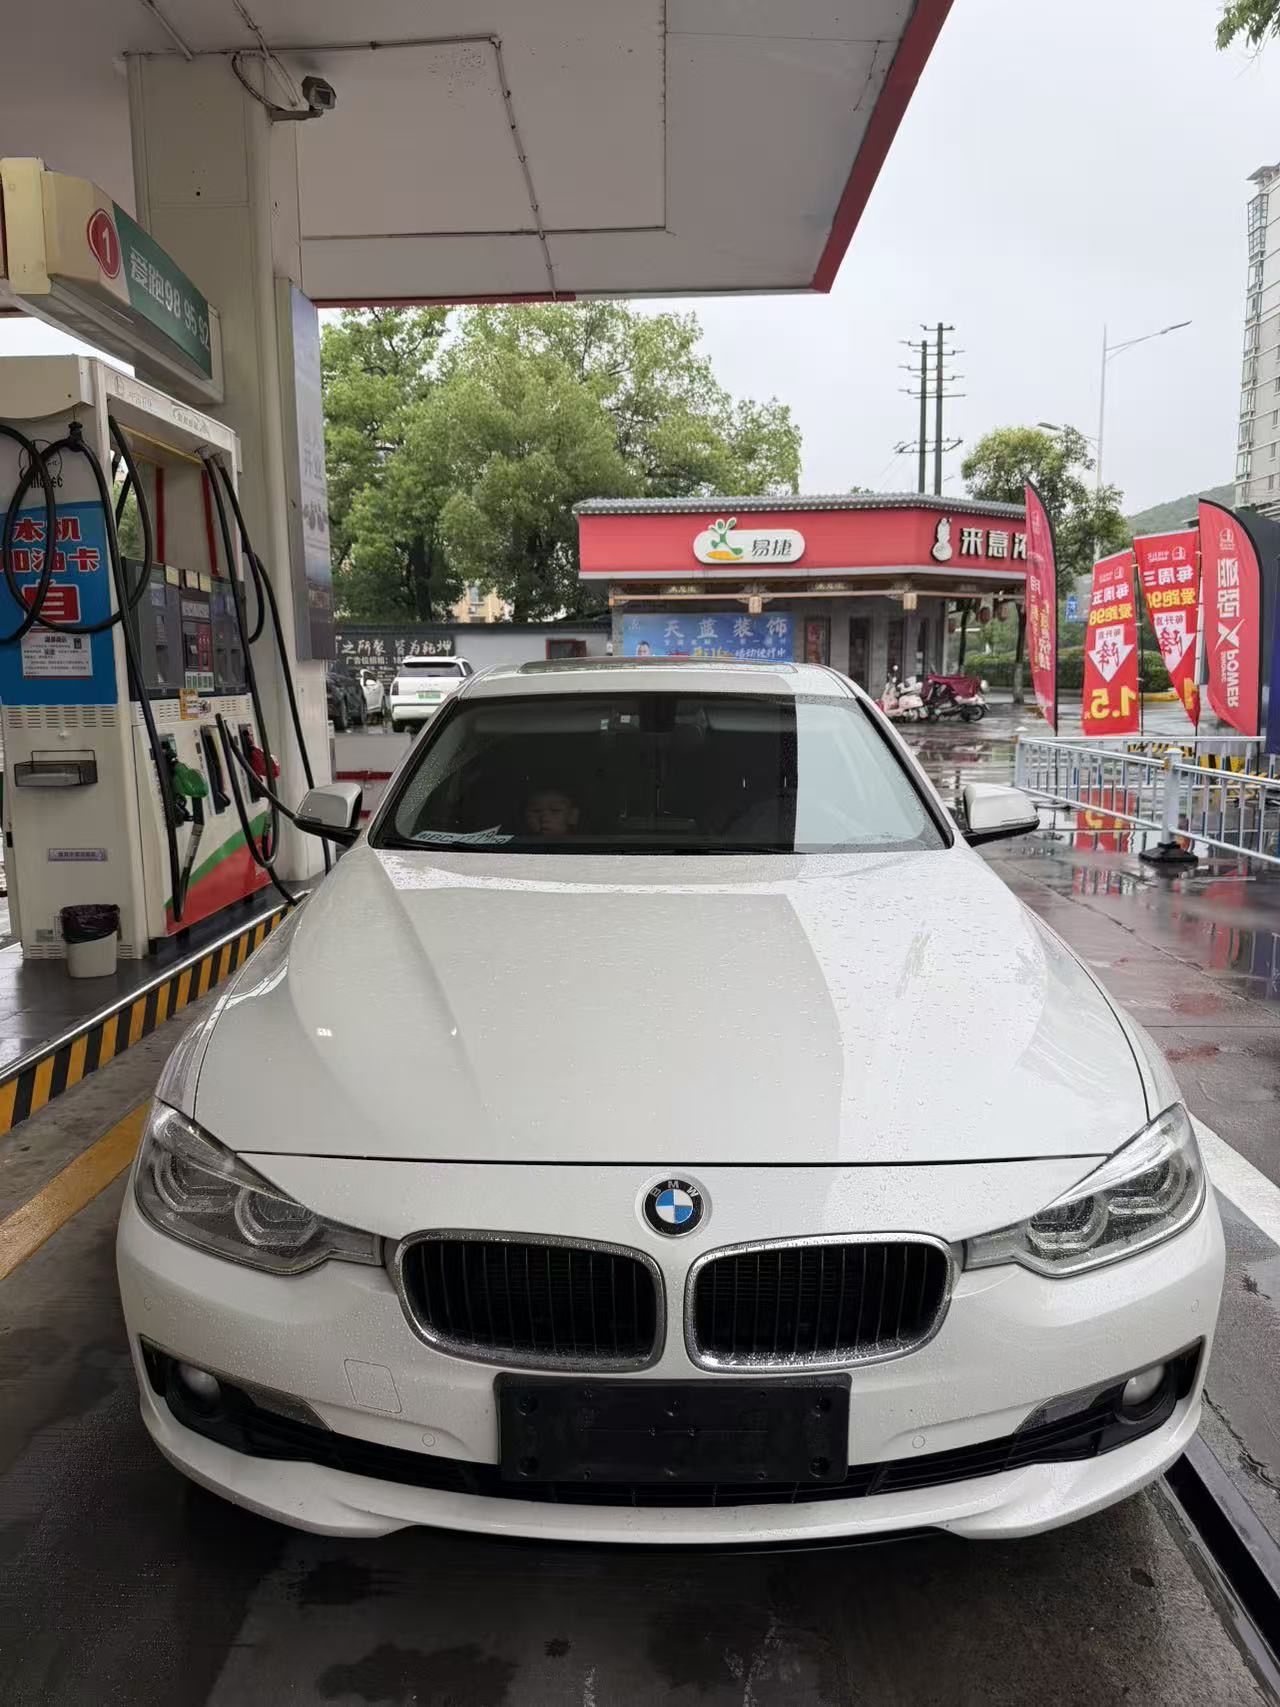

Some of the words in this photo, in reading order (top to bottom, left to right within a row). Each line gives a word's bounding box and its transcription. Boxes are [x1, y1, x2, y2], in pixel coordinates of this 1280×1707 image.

[102, 228, 111, 264] 1
[130, 247, 181, 319] 爱跑98
[184, 299, 197, 336] 95
[751, 539, 792, 557] 易捷
[664, 616, 789, 639] 天蓝装饰
[649, 1180, 699, 1197] BMW
